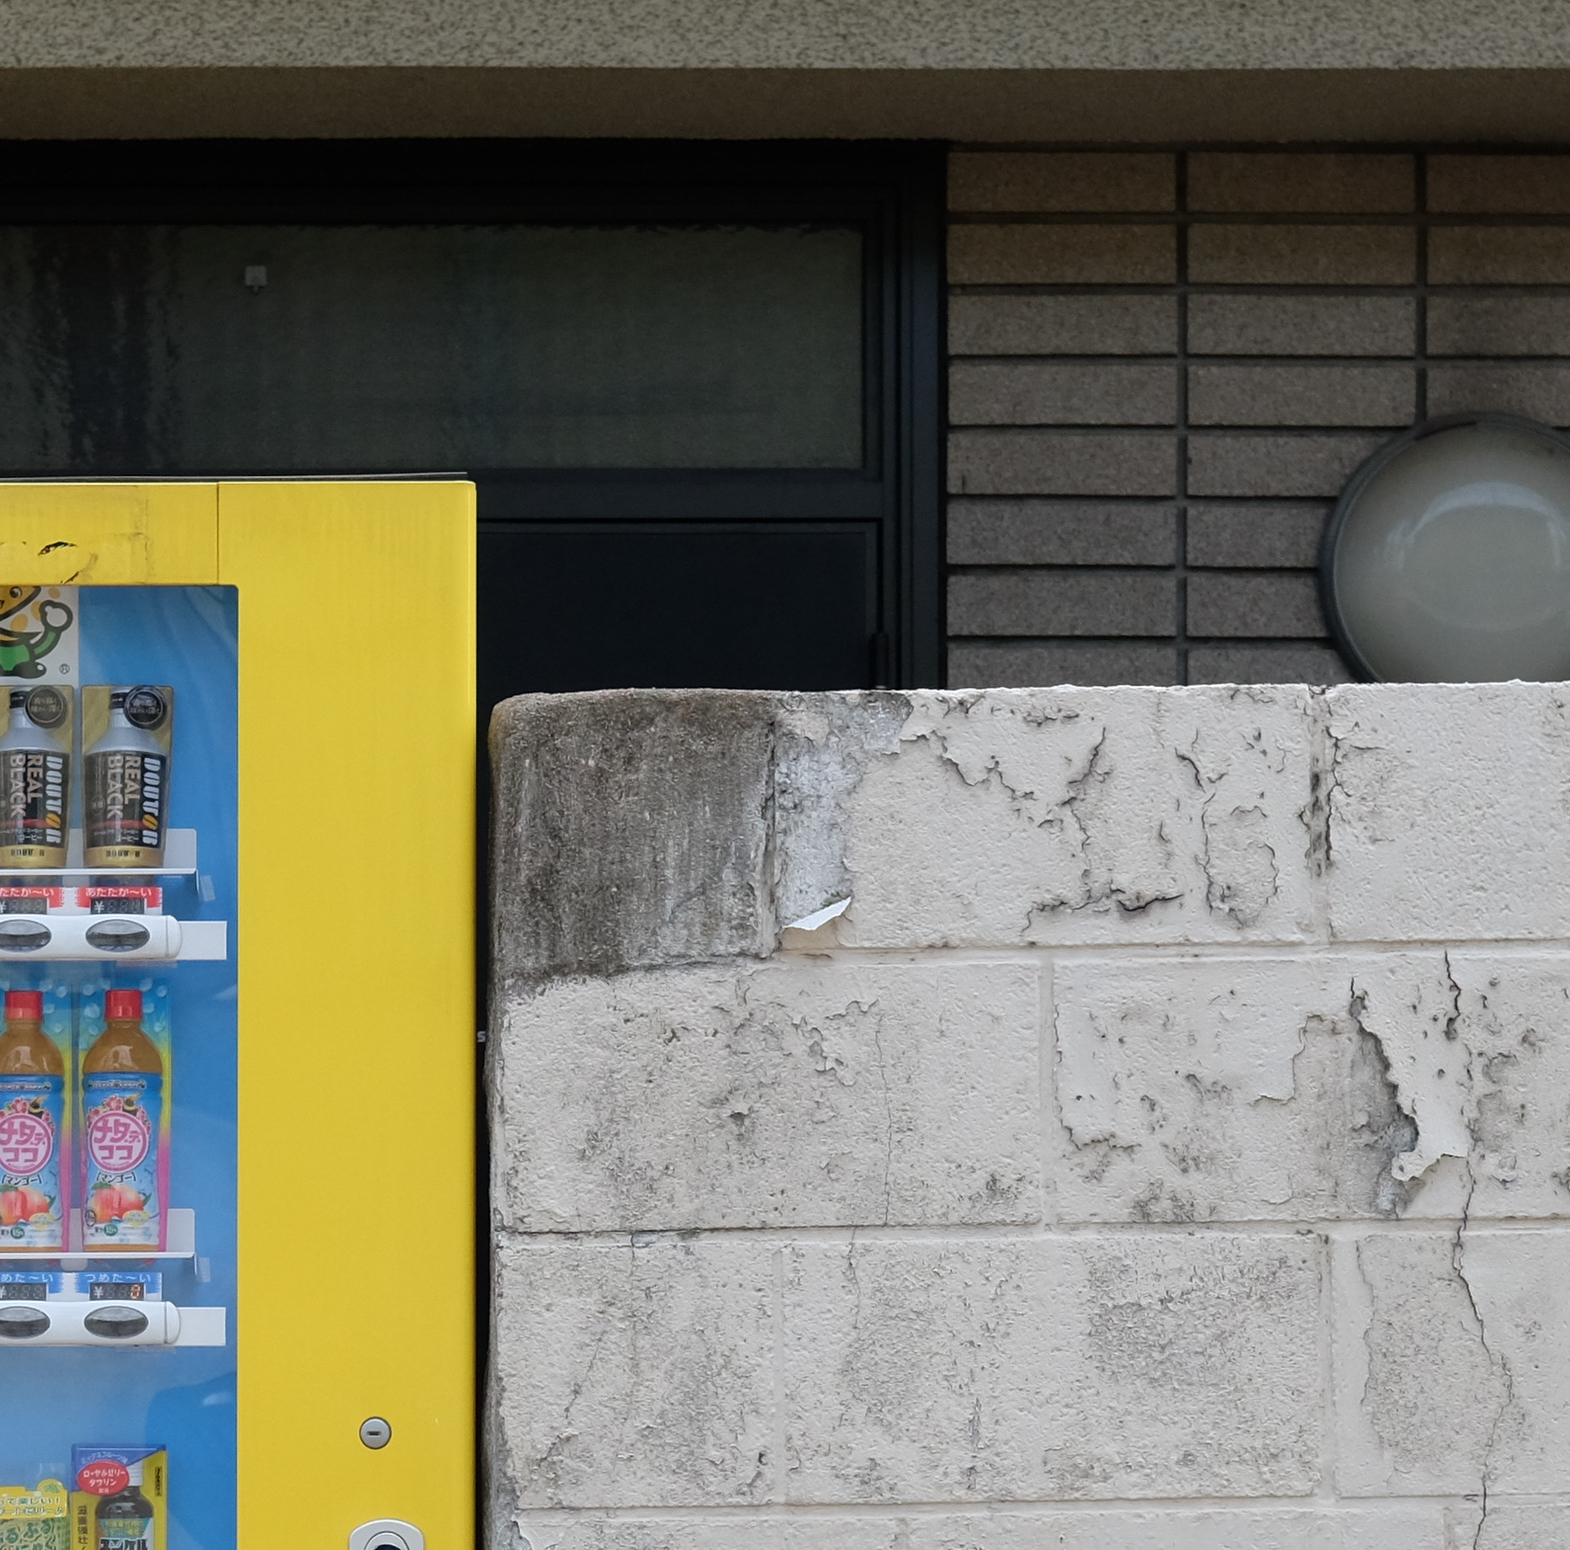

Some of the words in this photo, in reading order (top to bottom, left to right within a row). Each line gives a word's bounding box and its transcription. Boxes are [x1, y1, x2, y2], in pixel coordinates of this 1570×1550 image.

[10, 755, 26, 818] BLACK
[27, 754, 43, 804] REAL
[108, 757, 123, 819] BLACK
[125, 756, 141, 805] REAL
